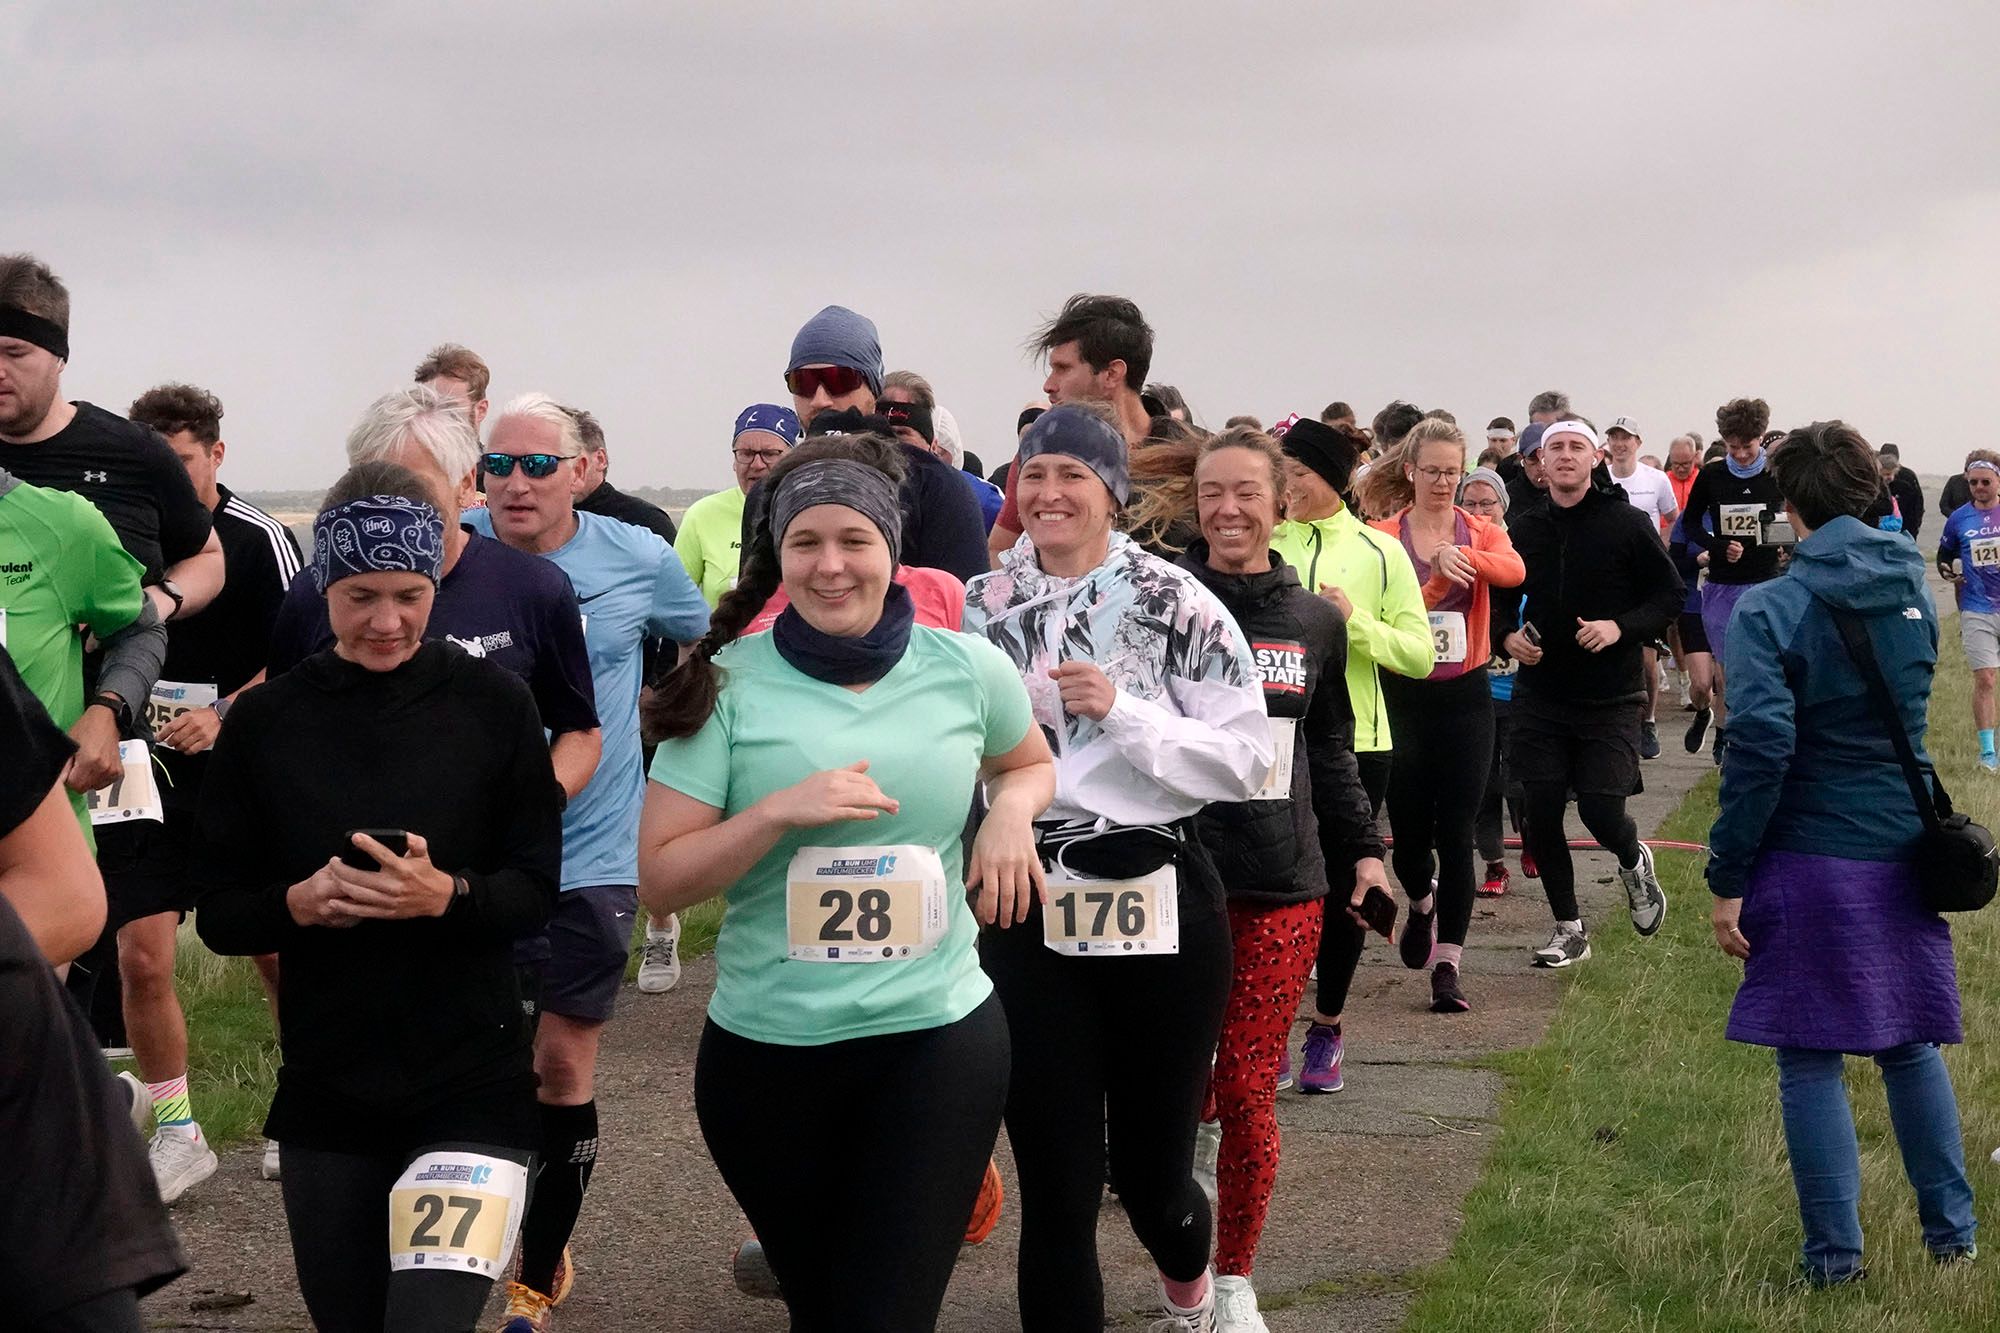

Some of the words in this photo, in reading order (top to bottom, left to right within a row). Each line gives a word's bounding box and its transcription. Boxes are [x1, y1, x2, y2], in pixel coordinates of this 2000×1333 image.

[365, 519, 392, 533] Buff
[1725, 516, 1756, 531] 122
[1979, 525, 2000, 536] CLA
[1975, 547, 1999, 562] 121
[1256, 648, 1305, 671] SYLT
[1256, 665, 1307, 688] STATE
[845, 859, 861, 867] RUN
[818, 888, 892, 942] 28
[1056, 890, 1146, 937] 176
[441, 1164, 457, 1173] RUN
[456, 1165, 473, 1174] UMS
[409, 1193, 483, 1249] 27
